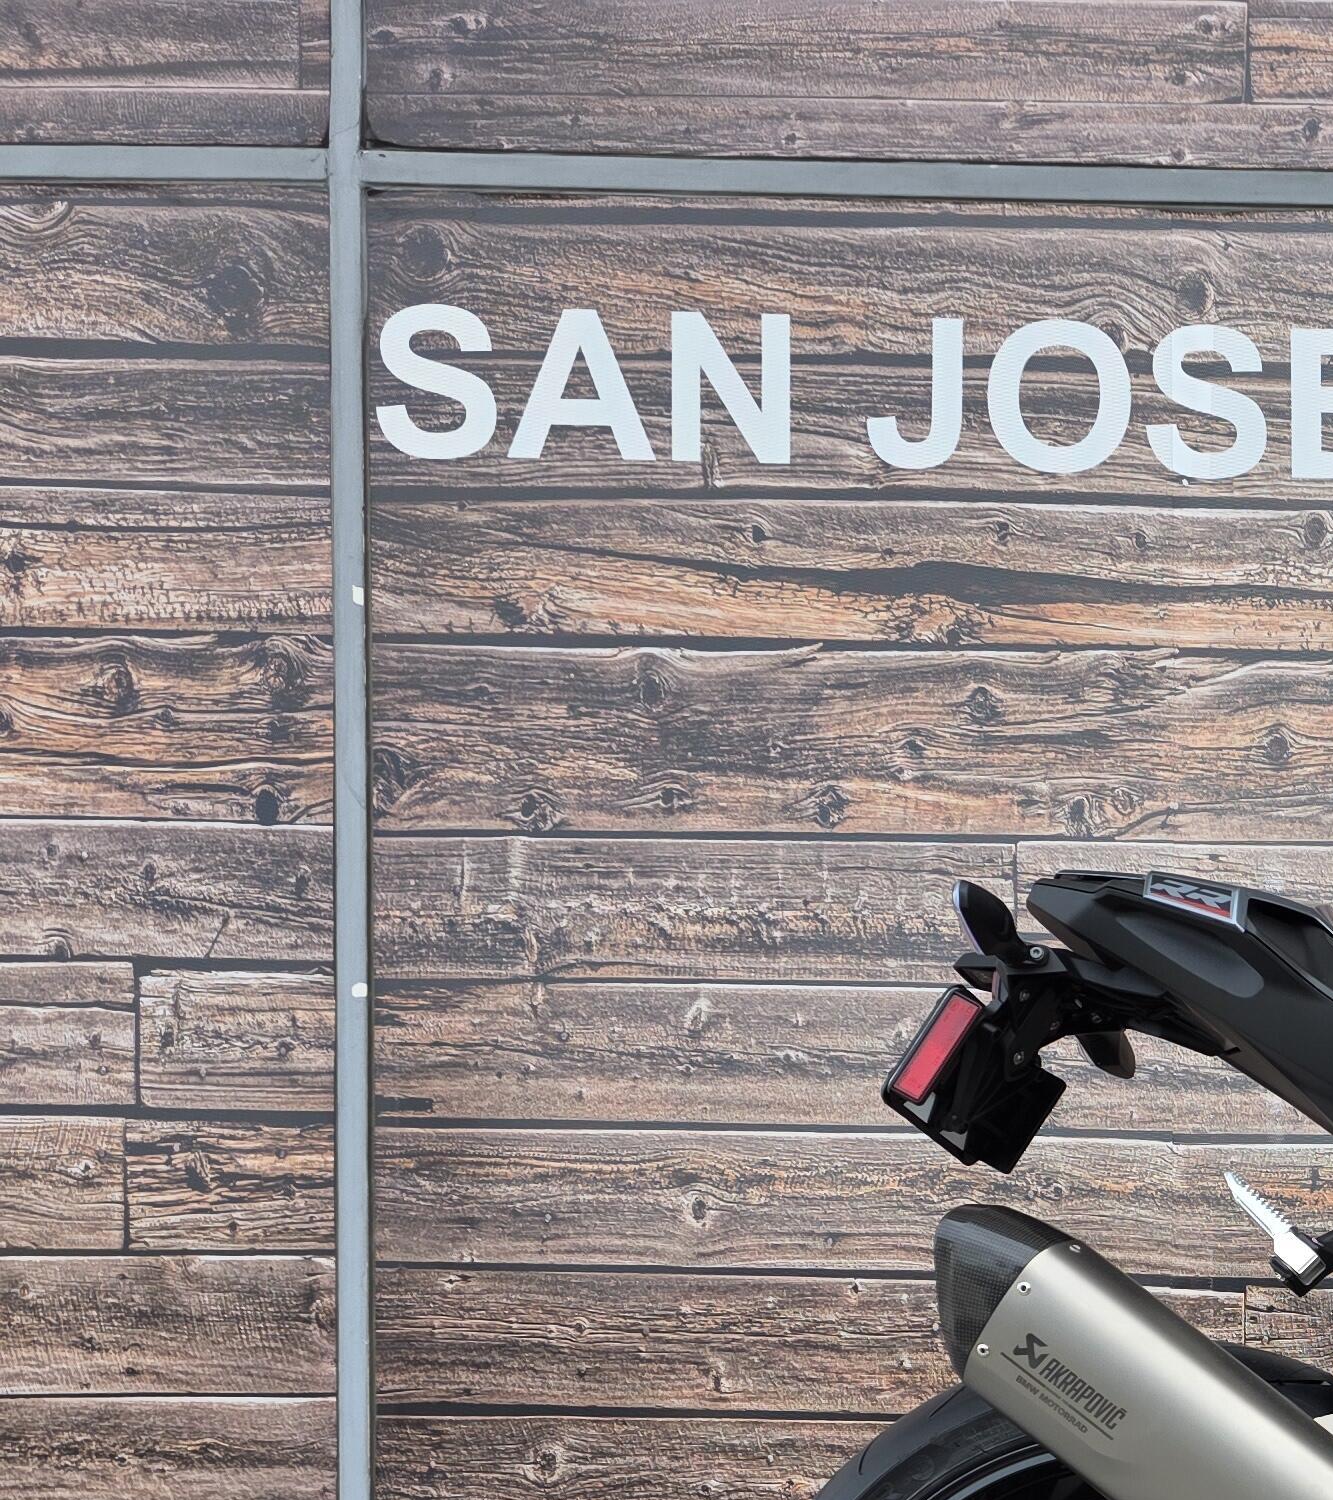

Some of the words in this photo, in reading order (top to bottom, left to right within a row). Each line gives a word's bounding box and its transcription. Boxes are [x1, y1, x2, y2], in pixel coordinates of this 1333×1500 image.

[375, 303, 791, 464] SAN
[1150, 880, 1232, 909] RR
[1016, 1375, 1040, 1396] BMW
[1039, 1392, 1089, 1434] MOTORRAD
[1038, 1358, 1128, 1431] AKRAPOVIČ
